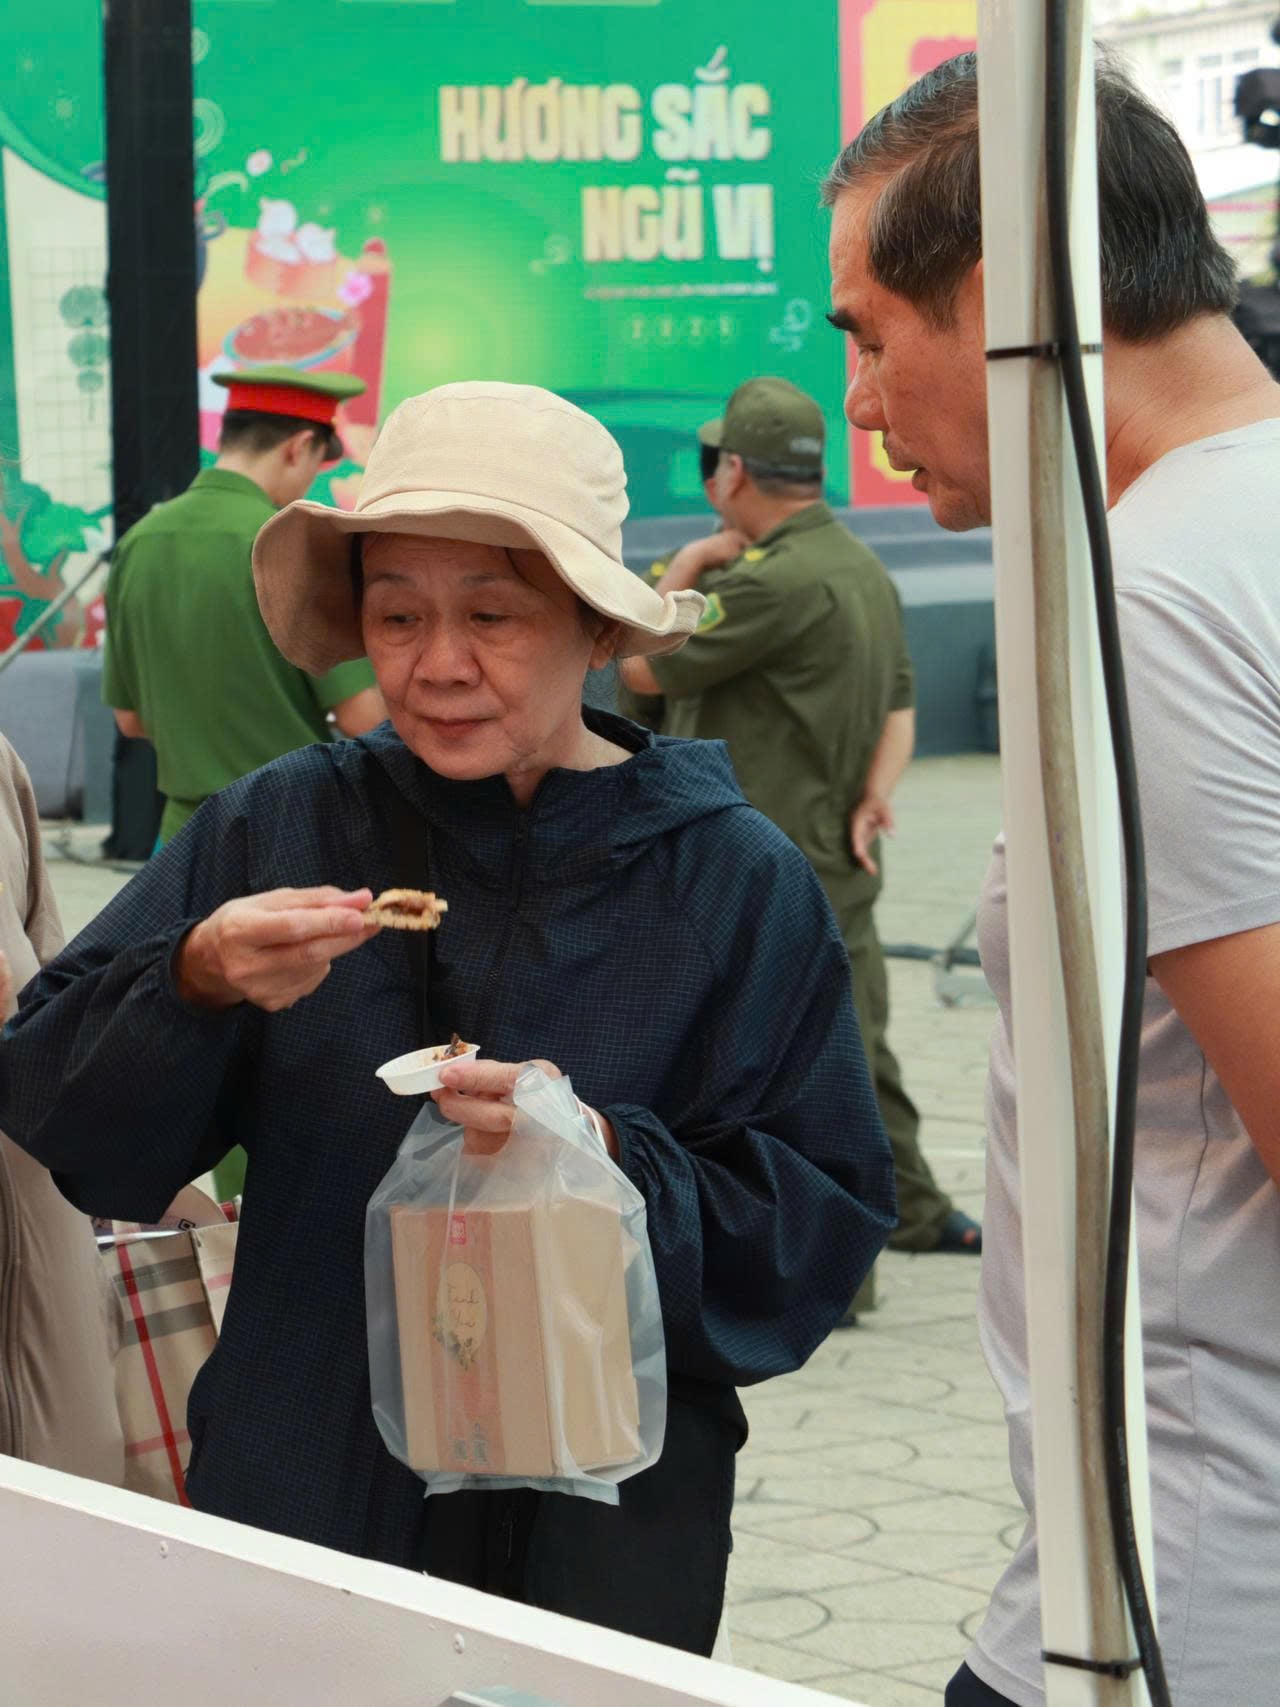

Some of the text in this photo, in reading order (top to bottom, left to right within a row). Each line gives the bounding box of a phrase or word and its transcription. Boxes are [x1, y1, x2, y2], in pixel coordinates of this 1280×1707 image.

[439, 45, 771, 162] HƯƠNG SẮC
[581, 167, 774, 273] NGŨ VỊ
